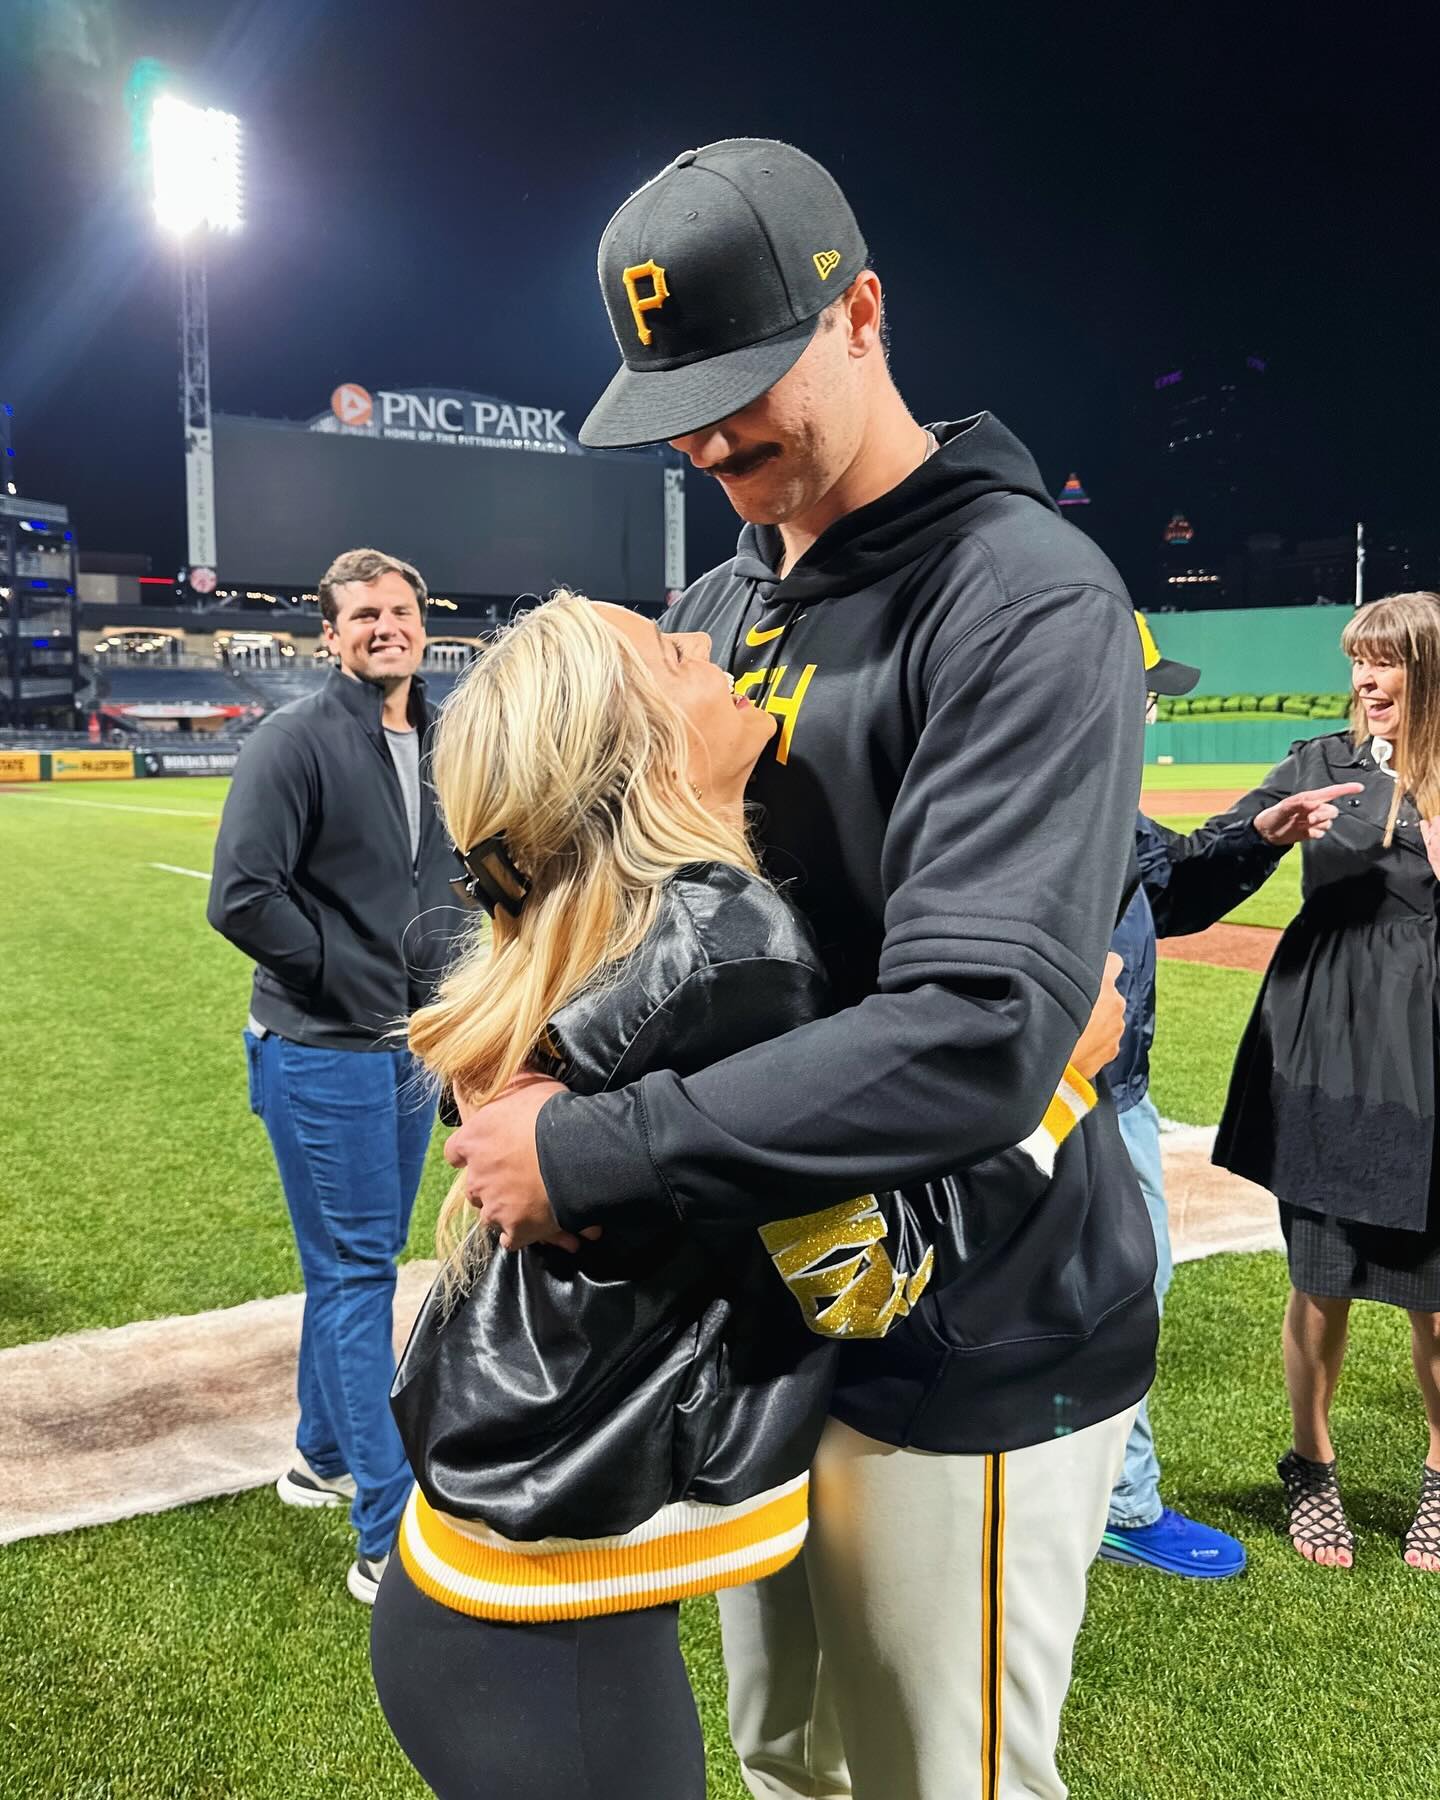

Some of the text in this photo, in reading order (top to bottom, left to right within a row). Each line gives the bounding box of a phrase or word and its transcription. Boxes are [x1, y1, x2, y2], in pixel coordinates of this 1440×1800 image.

[622, 258, 671, 347] P
[378, 391, 566, 441] PNC PARK
[384, 427, 416, 440] HOME
[418, 430, 433, 441] OF
[435, 431, 457, 445] THE
